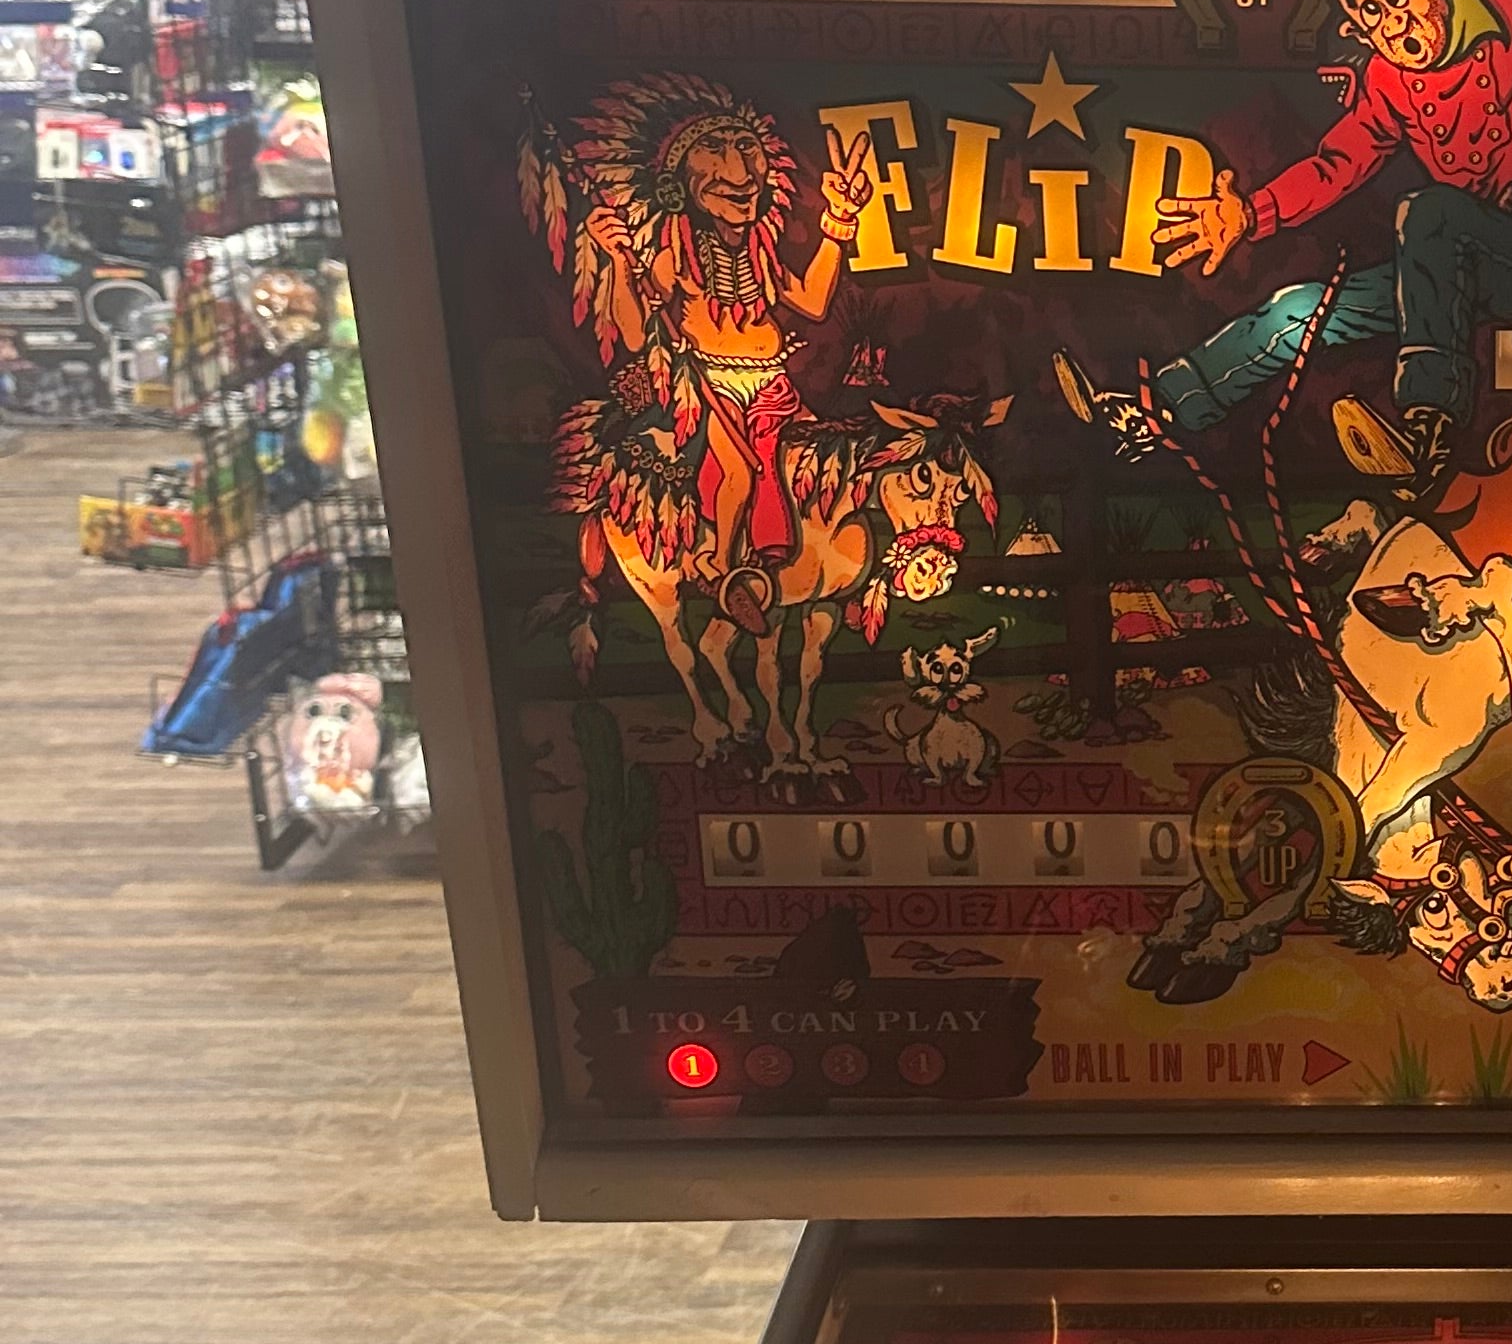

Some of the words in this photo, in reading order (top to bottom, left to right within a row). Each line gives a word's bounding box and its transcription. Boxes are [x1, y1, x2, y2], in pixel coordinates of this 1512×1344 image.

[1264, 809, 1287, 837] 3
[1259, 844, 1298, 886] UP
[611, 1005, 634, 1034] 1
[647, 1011, 706, 1034] TO
[720, 1004, 754, 1033] 4
[770, 1011, 858, 1034] CAN
[877, 1009, 988, 1034] PLAY
[686, 1054, 700, 1077] 1
[1051, 1042, 1131, 1084] BALL
[1147, 1042, 1183, 1084] IN
[1206, 1042, 1285, 1084] PLAY
